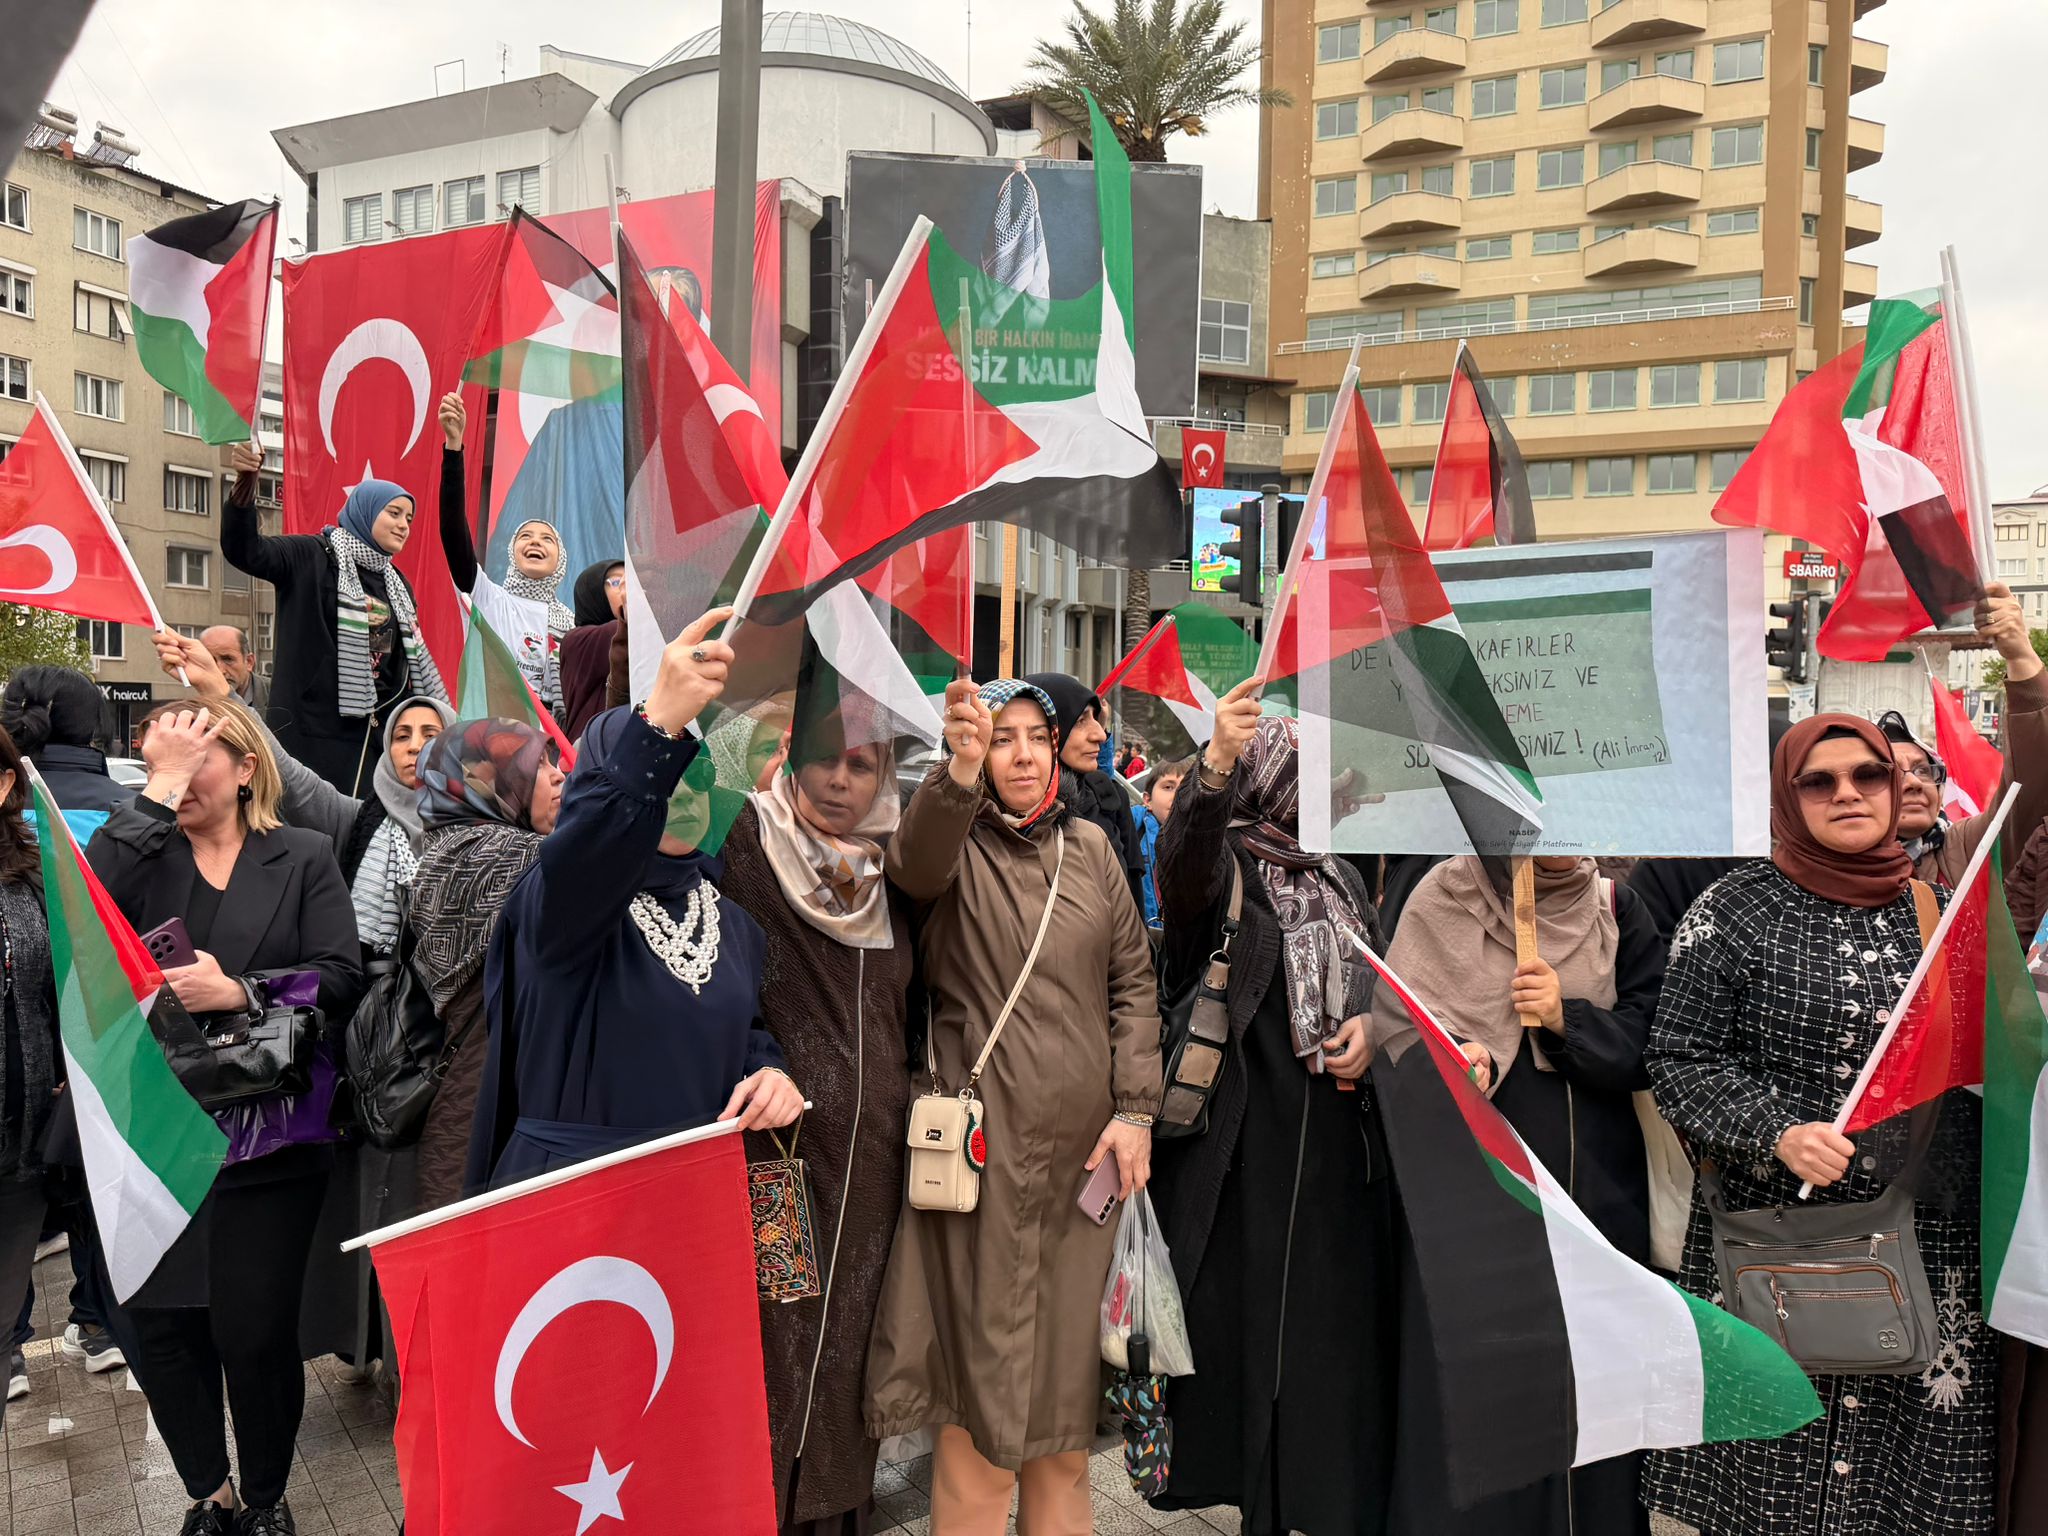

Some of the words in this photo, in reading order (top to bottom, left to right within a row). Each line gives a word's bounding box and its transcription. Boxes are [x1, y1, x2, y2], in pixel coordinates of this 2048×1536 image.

[1059, 327, 1100, 349] İDAM
[1017, 355, 1097, 387] KALM
[1788, 563, 1836, 578] SBARRO
[1352, 646, 1377, 671] DE
[1476, 632, 1576, 662] KAFİRLER
[1575, 666, 1601, 687] VE
[113, 689, 148, 701] haircut
[1501, 702, 1545, 724] EME
[1403, 743, 1430, 769] SÜ
[1513, 731, 1567, 758] SİNİZ
[1542, 840, 1583, 848] Platformu
